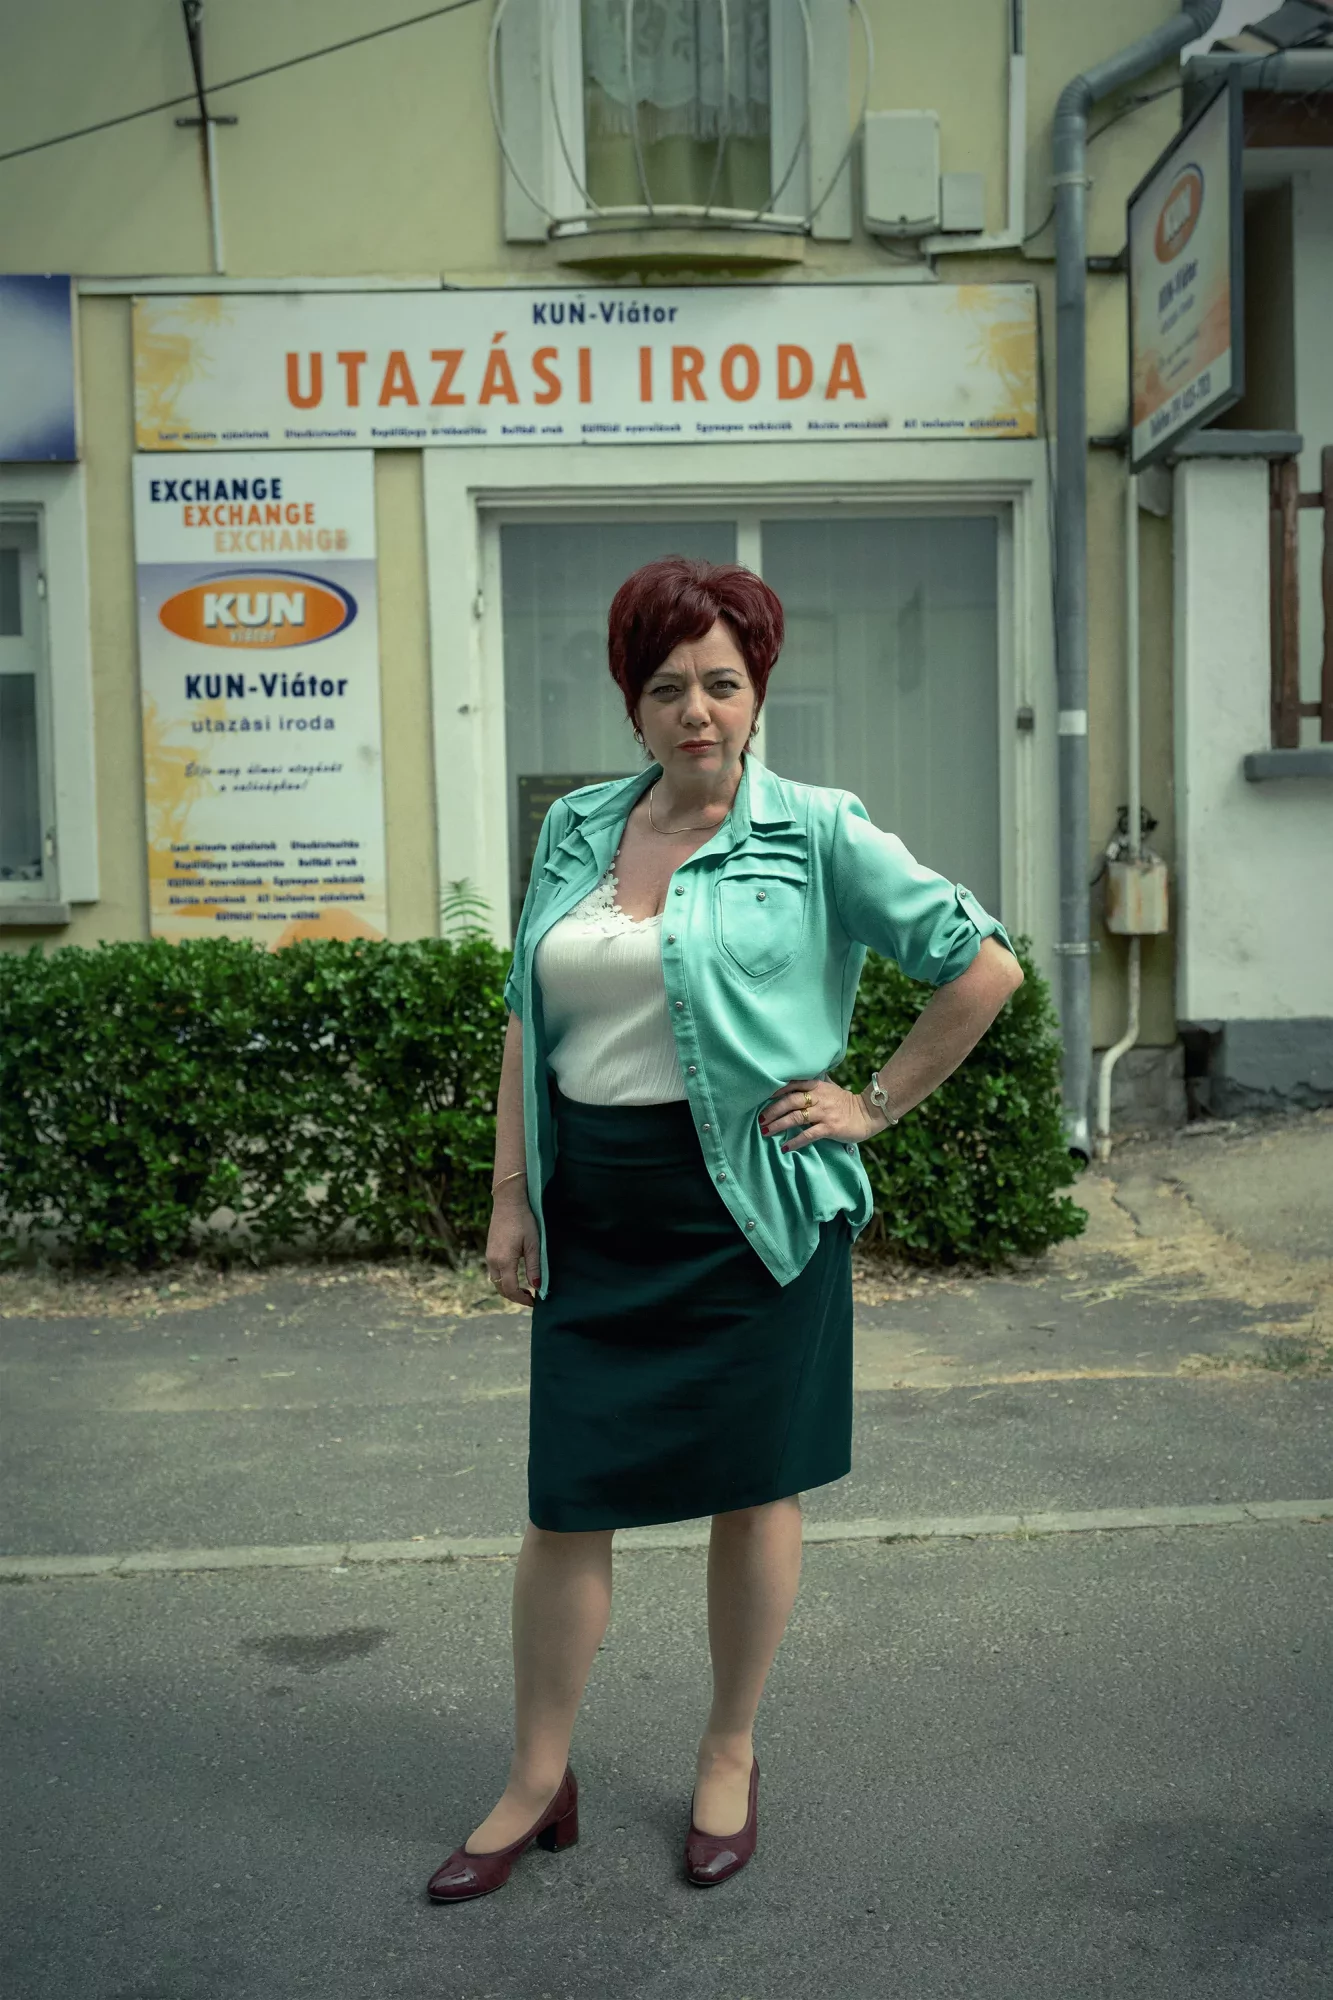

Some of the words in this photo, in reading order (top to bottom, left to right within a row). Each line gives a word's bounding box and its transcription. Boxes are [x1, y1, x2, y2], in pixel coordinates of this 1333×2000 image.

[533, 301, 678, 325] KUN-Viátor
[286, 332, 591, 409] UTAZÁSI
[639, 343, 867, 403] IRODA
[150, 478, 282, 502] EXCHANGE
[183, 503, 315, 527] EXCHANGE
[215, 529, 349, 554] EXCHANGE
[203, 592, 306, 628] KUN
[186, 672, 348, 699] KUN-Viátor
[191, 715, 270, 733] utazási
[280, 715, 335, 731] iroda
